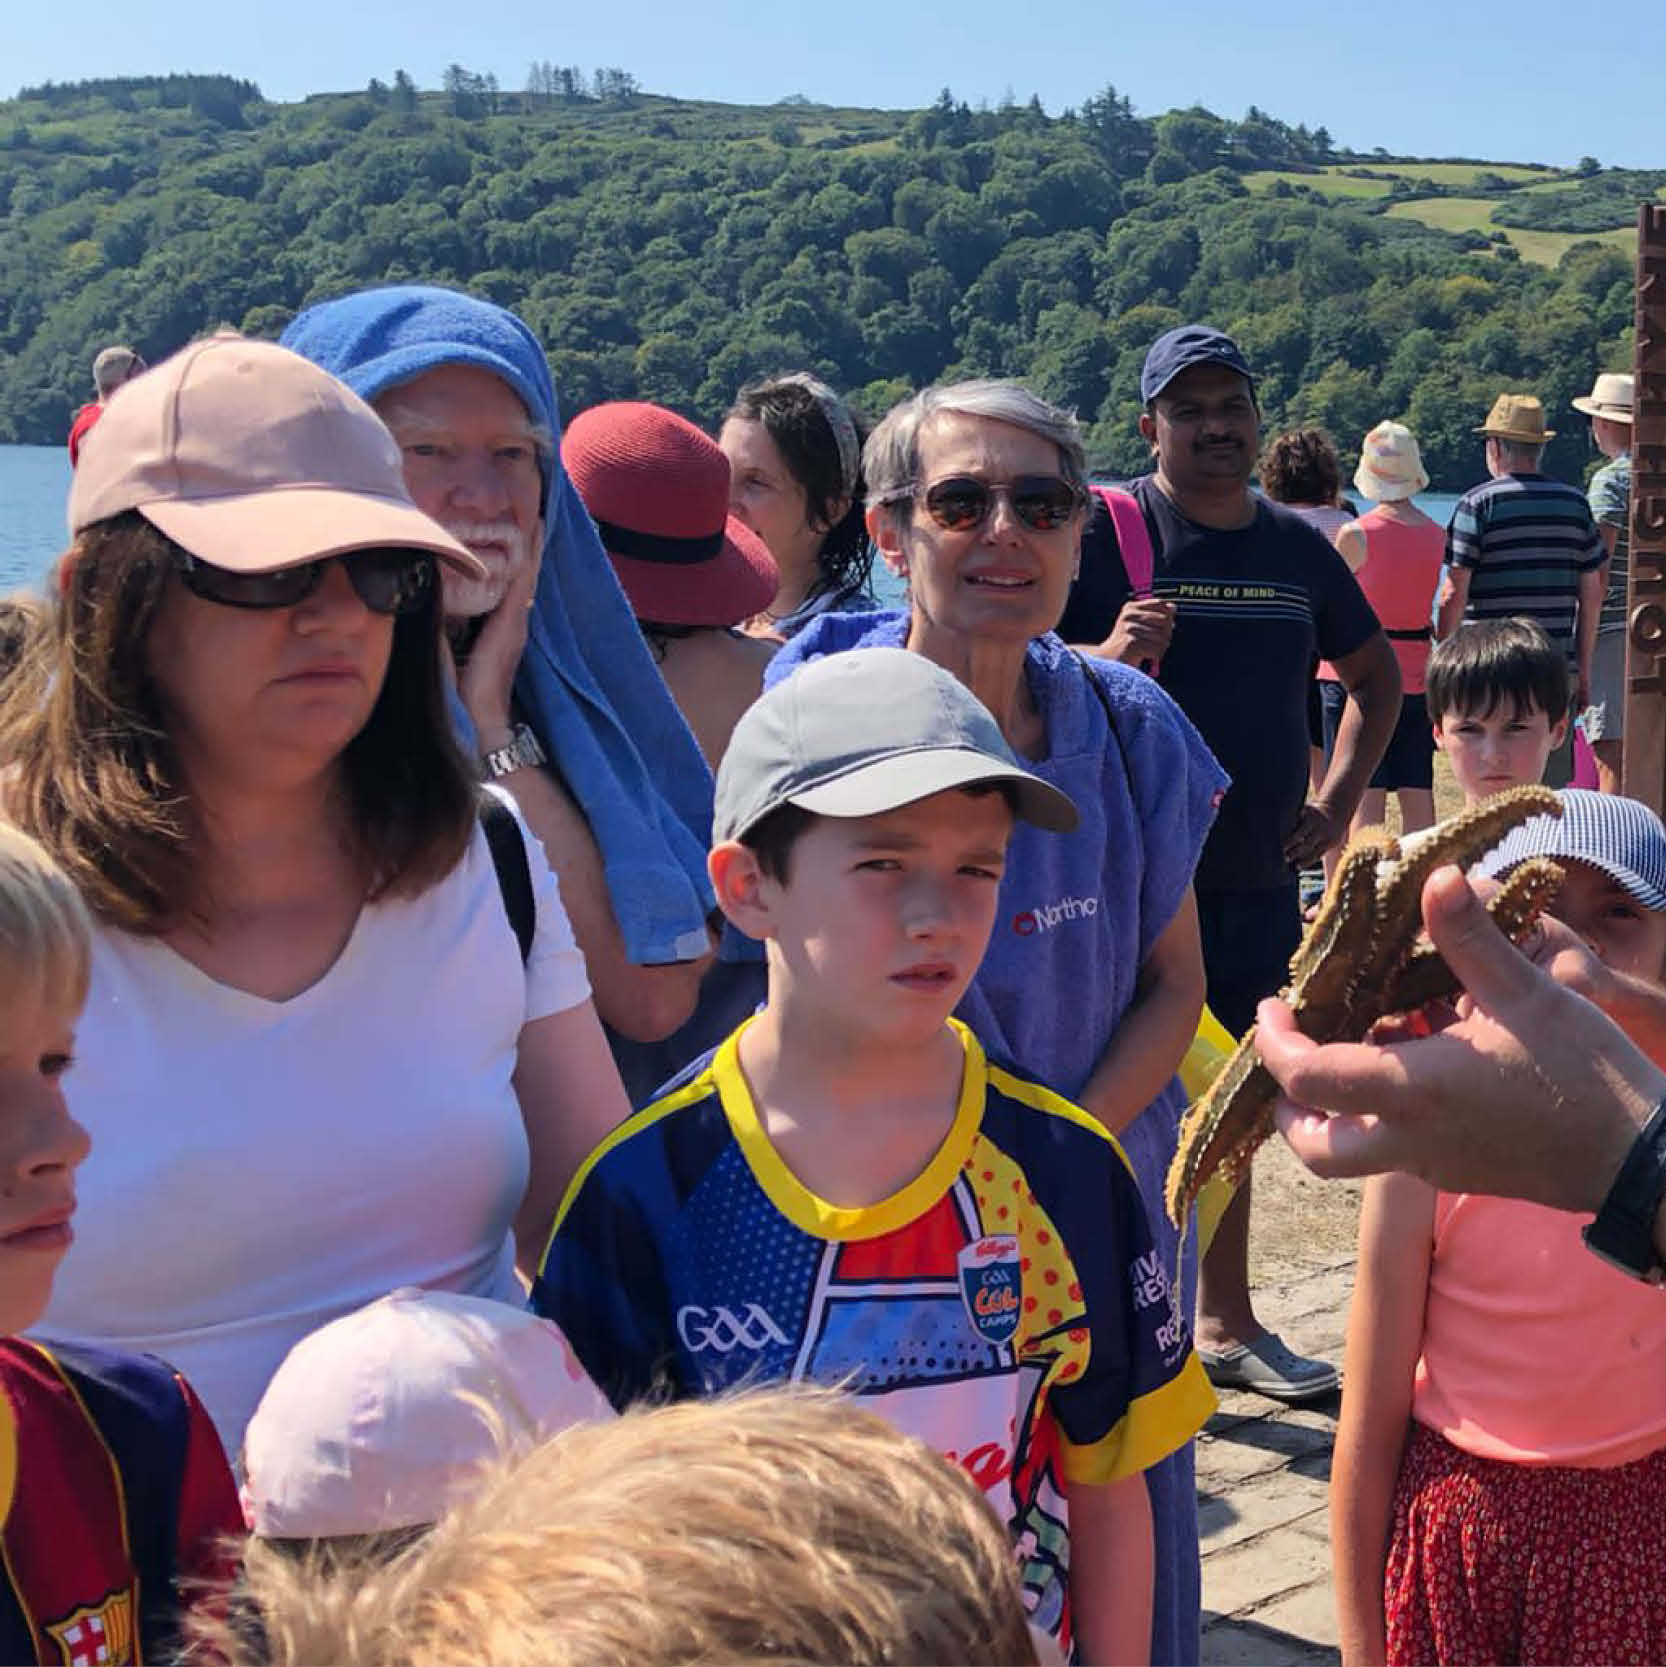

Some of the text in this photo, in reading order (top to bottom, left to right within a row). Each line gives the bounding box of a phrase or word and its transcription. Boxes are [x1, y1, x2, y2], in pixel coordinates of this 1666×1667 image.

[1178, 584, 1277, 599] PEACE OF MIND
